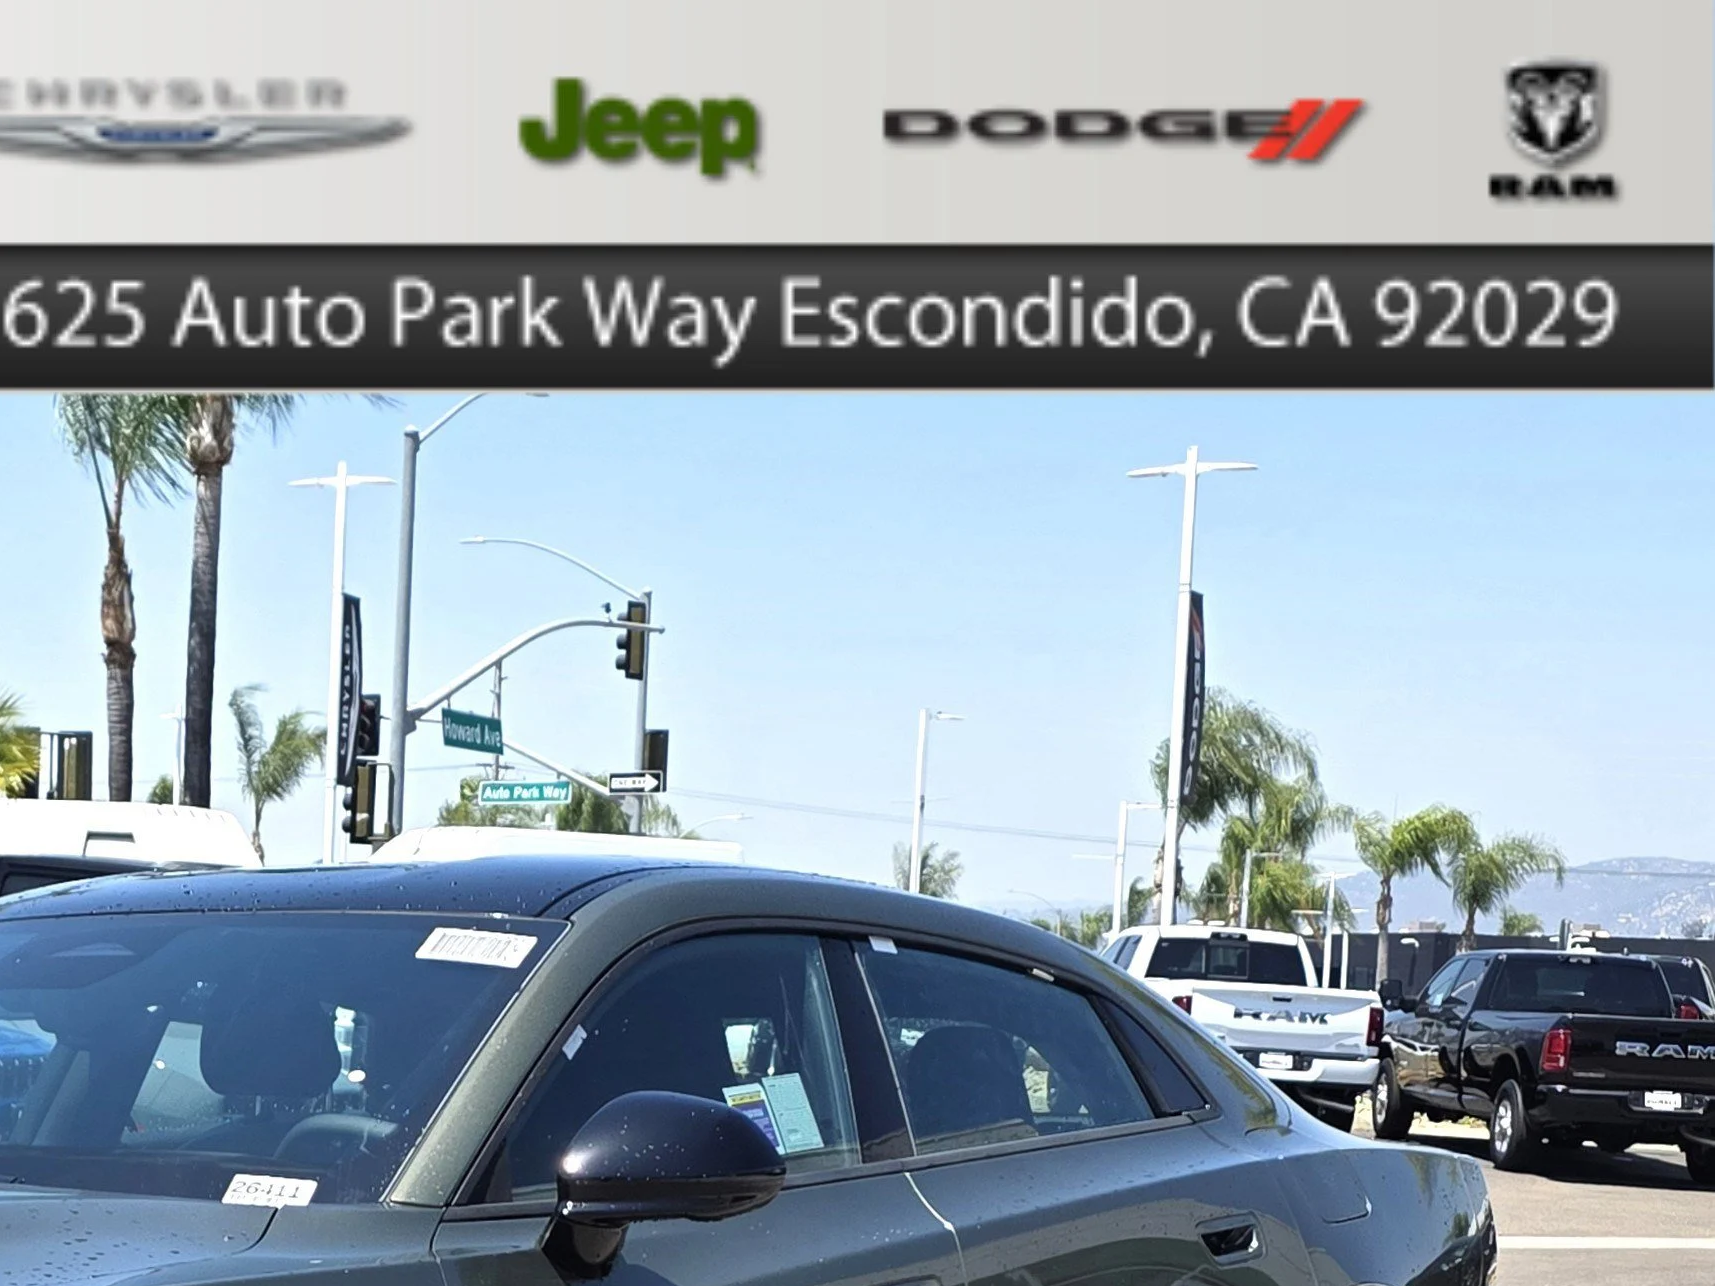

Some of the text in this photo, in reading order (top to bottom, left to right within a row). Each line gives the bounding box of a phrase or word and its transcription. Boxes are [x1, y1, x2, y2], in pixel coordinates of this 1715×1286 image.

[444, 717, 502, 747] Howard Ave
[483, 785, 567, 800] Auto Park Way
[1615, 1041, 1715, 1060] RAM
